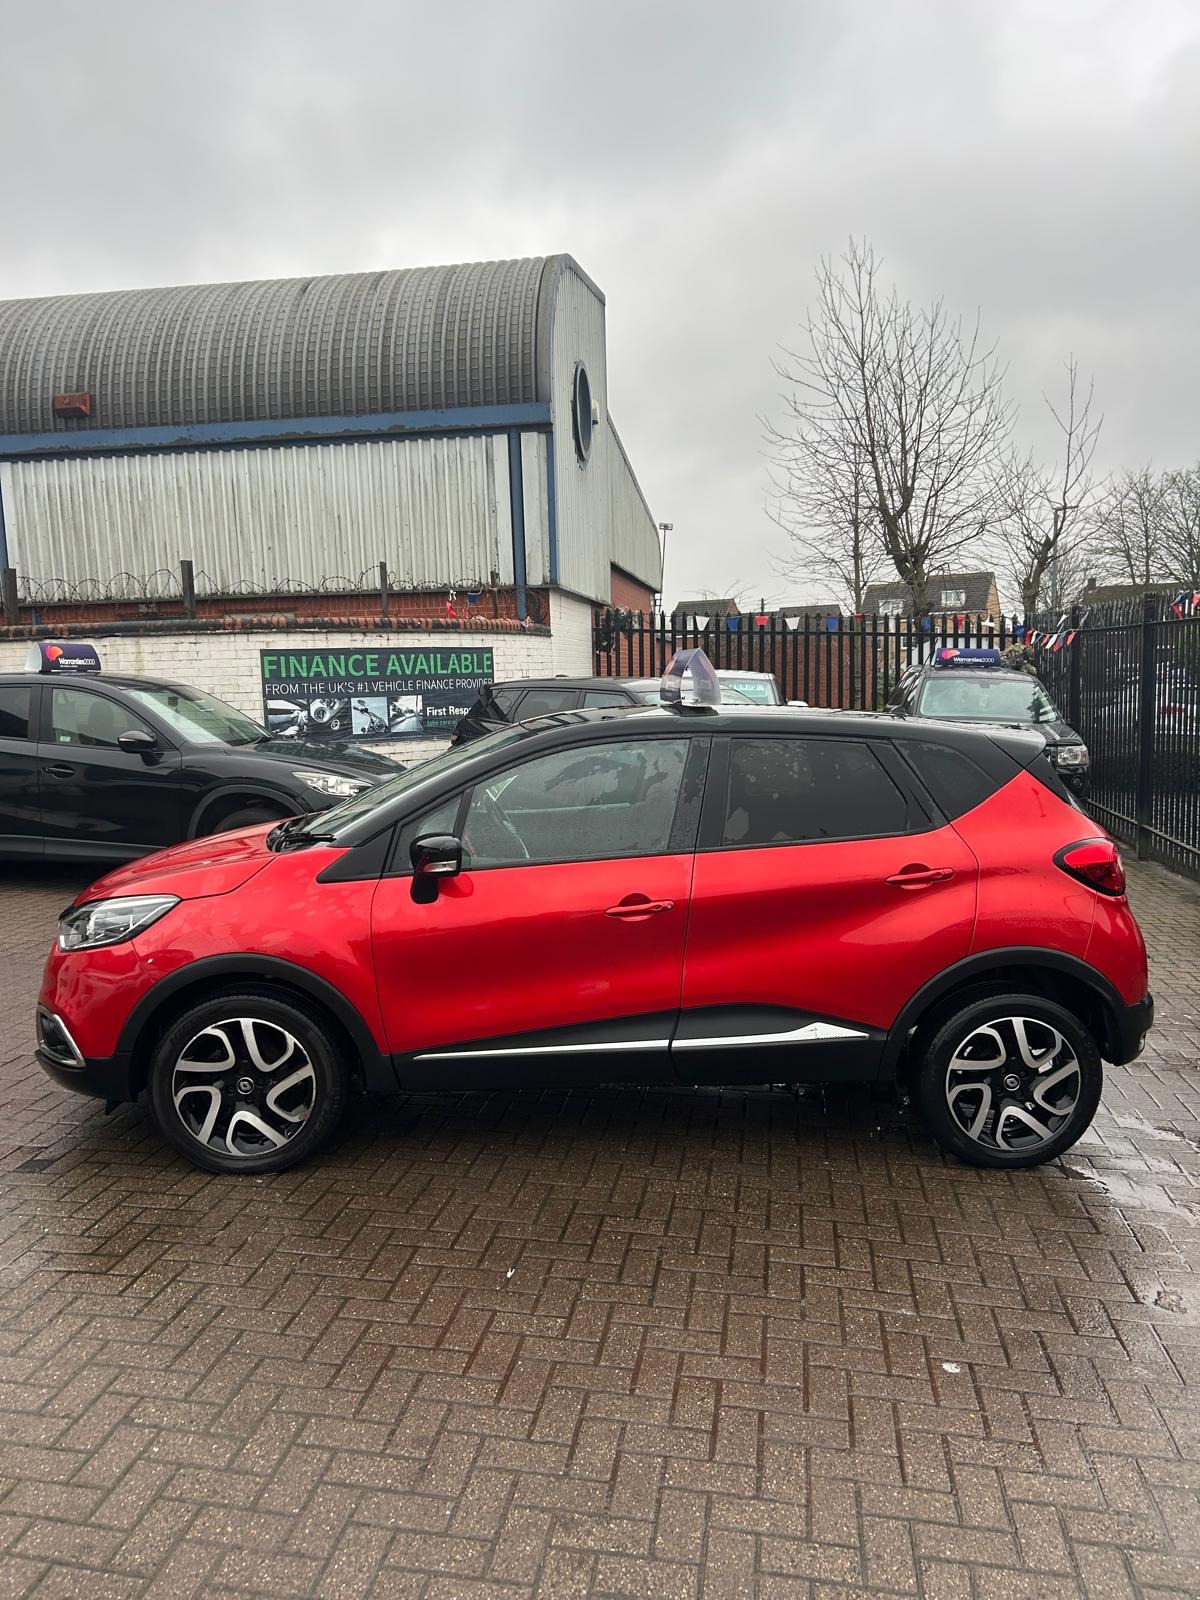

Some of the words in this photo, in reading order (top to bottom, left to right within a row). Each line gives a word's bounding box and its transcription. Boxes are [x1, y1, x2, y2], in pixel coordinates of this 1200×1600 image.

[263, 653, 380, 679] FINANCE
[385, 652, 492, 676] AVAILABLE
[265, 683, 299, 695] FROM
[301, 682, 326, 694] THE
[328, 681, 355, 693] UK'S
[357, 682, 370, 692] #1
[371, 680, 414, 692] VEHICLE
[416, 679, 454, 690] FINANCE
[426, 706, 447, 716] First
